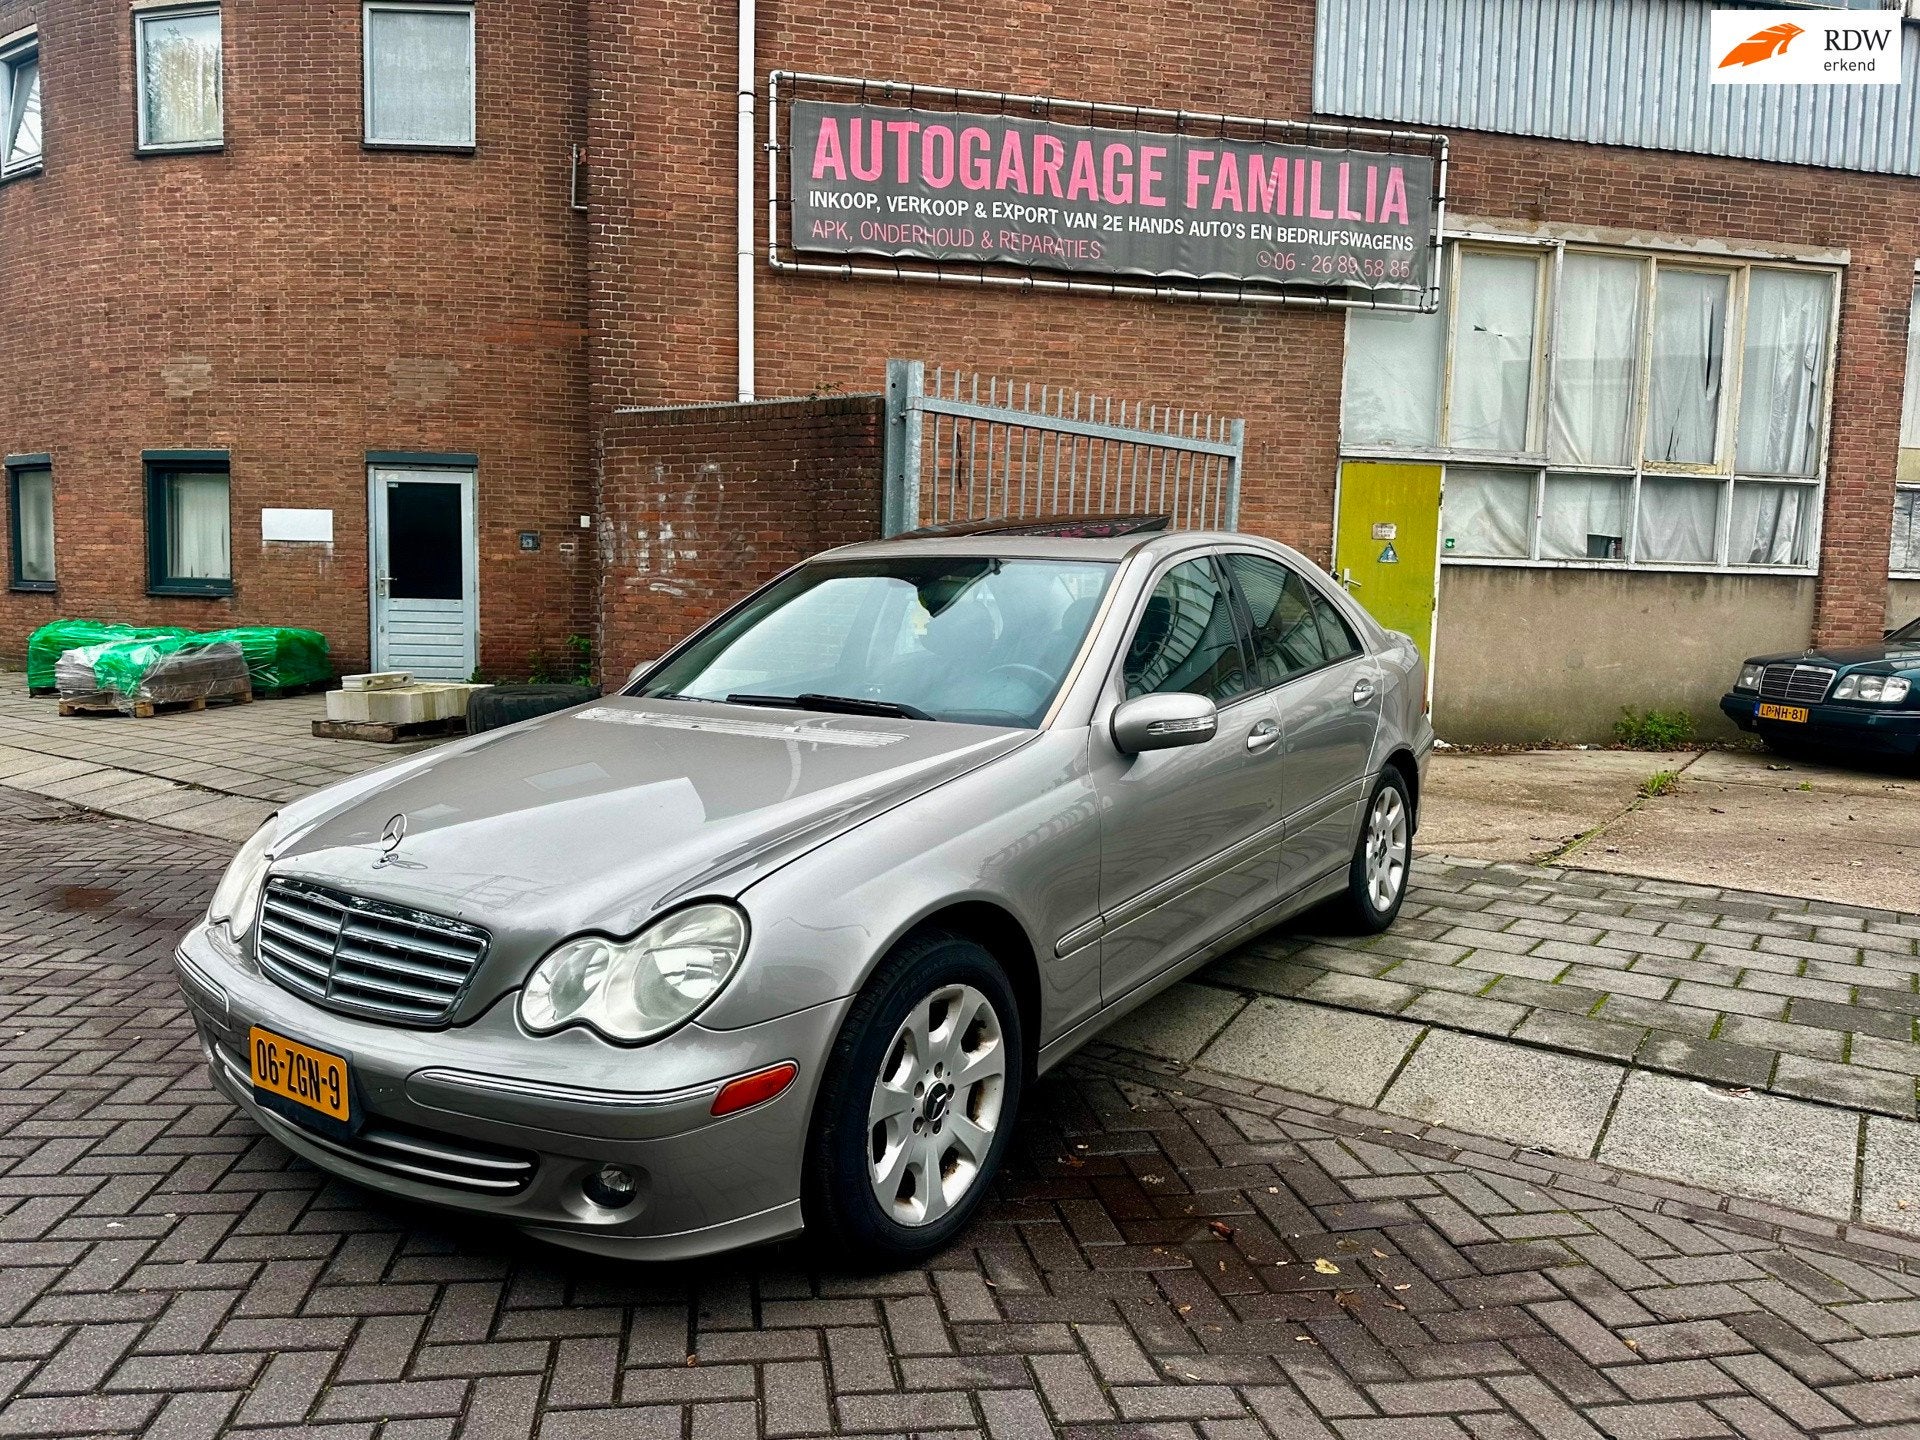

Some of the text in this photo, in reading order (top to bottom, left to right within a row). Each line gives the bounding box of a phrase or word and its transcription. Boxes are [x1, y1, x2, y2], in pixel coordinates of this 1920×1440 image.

[812, 117, 1409, 225] AUTOGARAGE FAMILLIA
[809, 190, 1414, 252] INKOOP, VERKOOP & EXPORT VAN 2E HANDS AUTO'S EN BEDRIJFSWAGENS
[811, 219, 1101, 260] APK, ONDERHOUD & REPARATIES
[1273, 252, 1296, 271] 06
[1311, 254, 1332, 274] 26
[1337, 255, 1358, 275] 89
[1364, 259, 1385, 277] 58
[1389, 259, 1411, 278] 85
[256, 1038, 340, 1110] 06-ZGN-9
